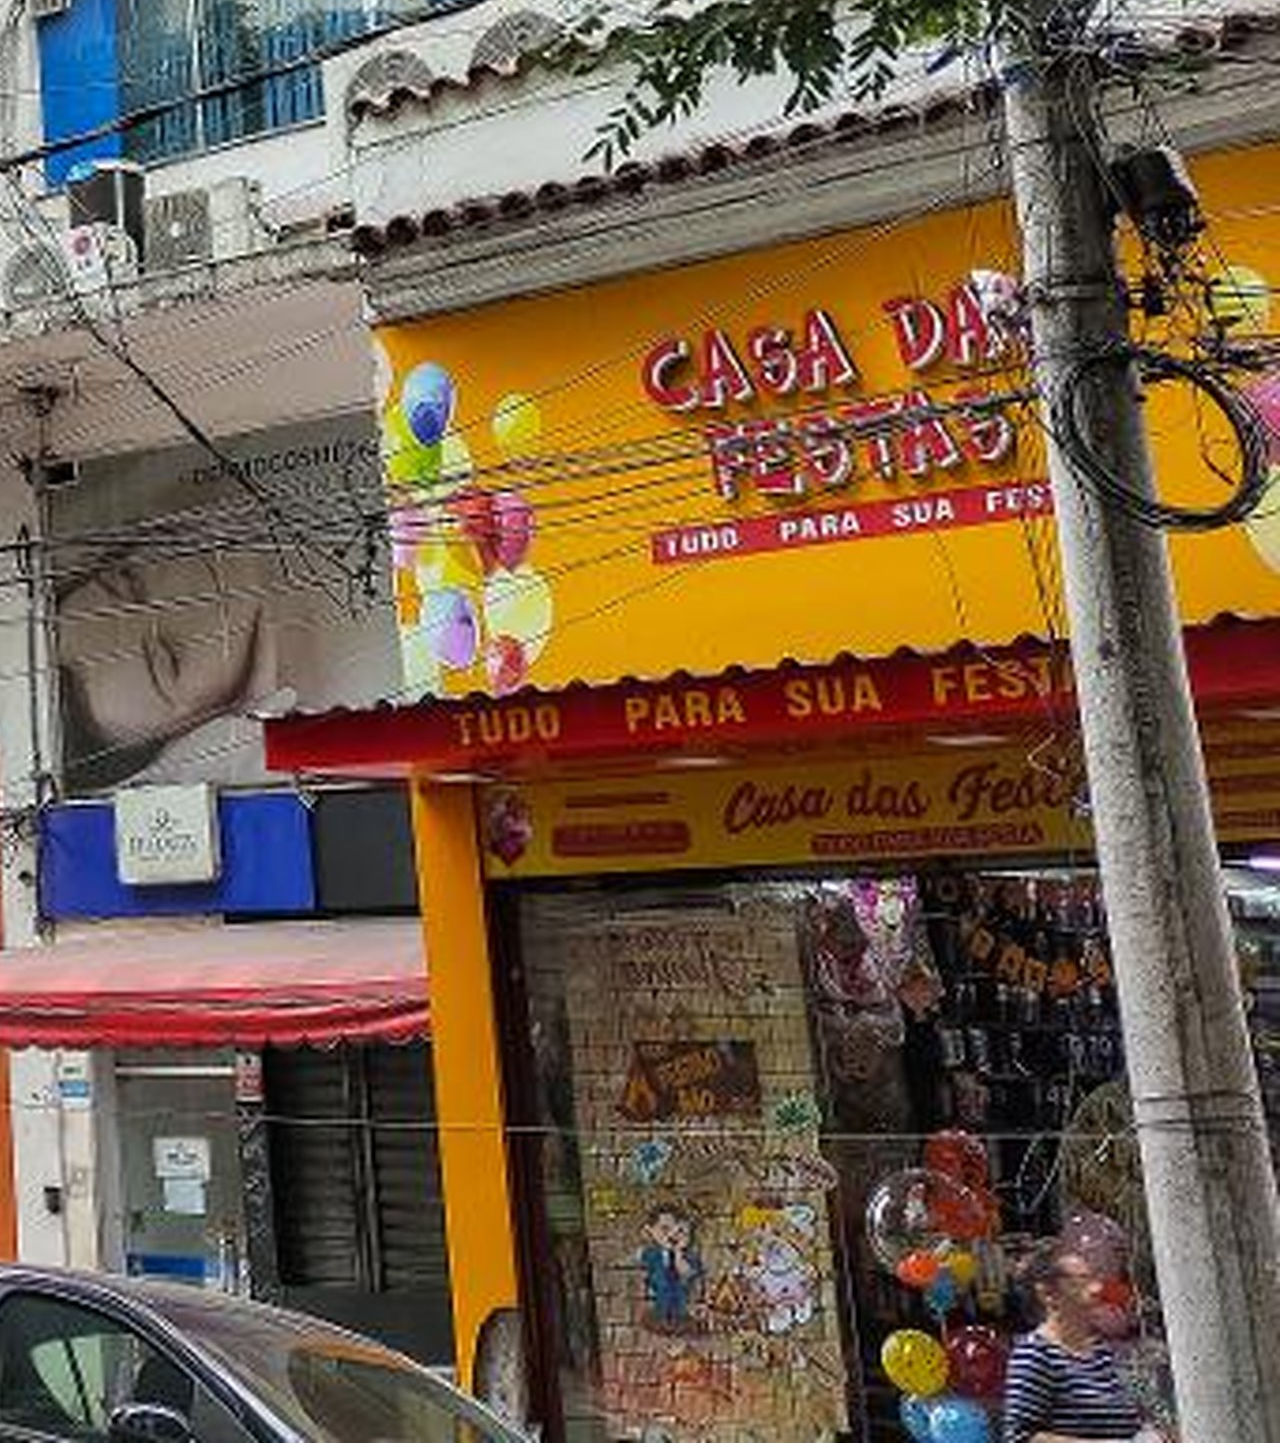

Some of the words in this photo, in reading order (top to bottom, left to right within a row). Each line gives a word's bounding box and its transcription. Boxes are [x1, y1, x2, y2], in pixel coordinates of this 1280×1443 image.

[646, 309, 858, 413] CASA
[882, 279, 1020, 371] DA
[666, 529, 740, 558] TUDO
[780, 517, 862, 543] PARA
[893, 497, 956, 524] SUA
[985, 483, 1055, 513] FES
[453, 705, 562, 747] TUDO
[625, 688, 747, 734] PARA
[786, 672, 885, 718] SUA
[724, 782, 834, 835] Casa
[846, 773, 930, 817] das
